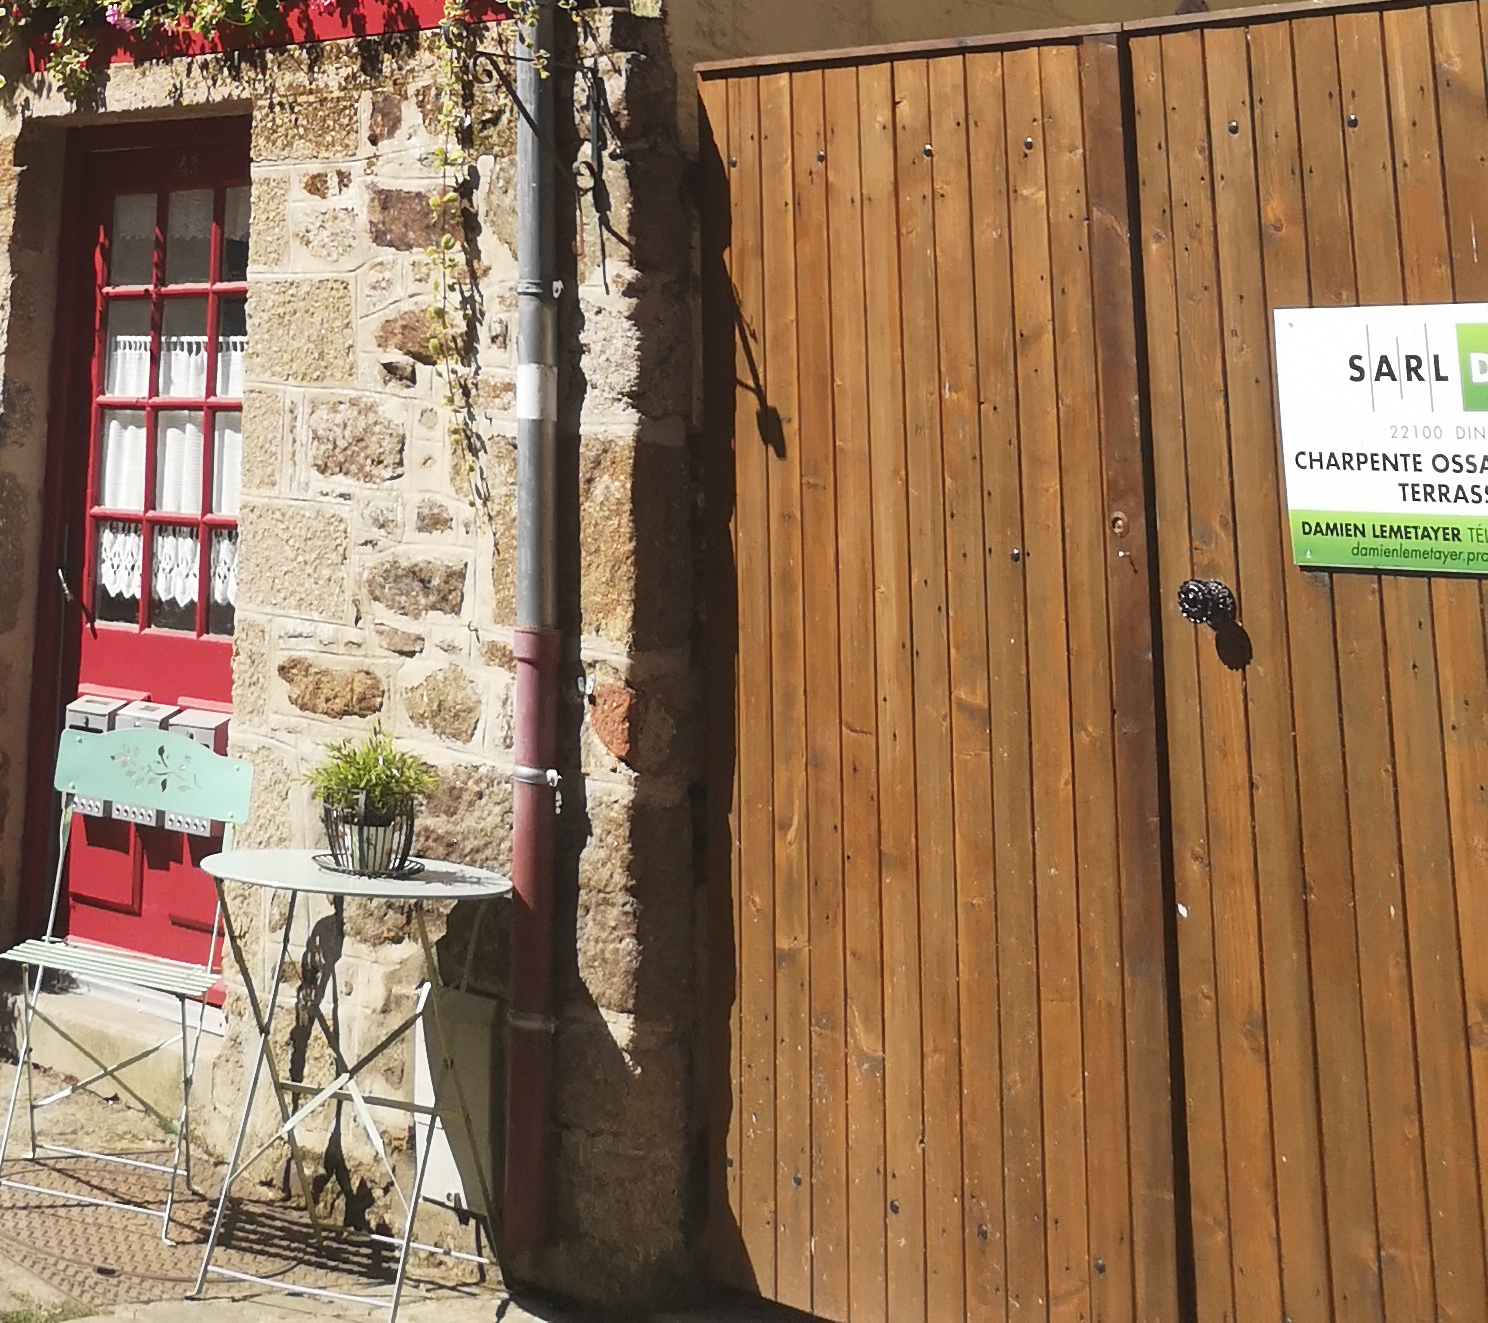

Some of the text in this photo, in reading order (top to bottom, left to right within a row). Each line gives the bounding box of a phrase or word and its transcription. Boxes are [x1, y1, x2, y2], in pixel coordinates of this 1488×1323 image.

[1348, 353, 1449, 383] SARL
[1389, 425, 1443, 440] 22100
[1294, 450, 1423, 473] CHARPENTE
[1301, 520, 1366, 539] DAMIEN
[1371, 523, 1461, 543] LEMETAYER
